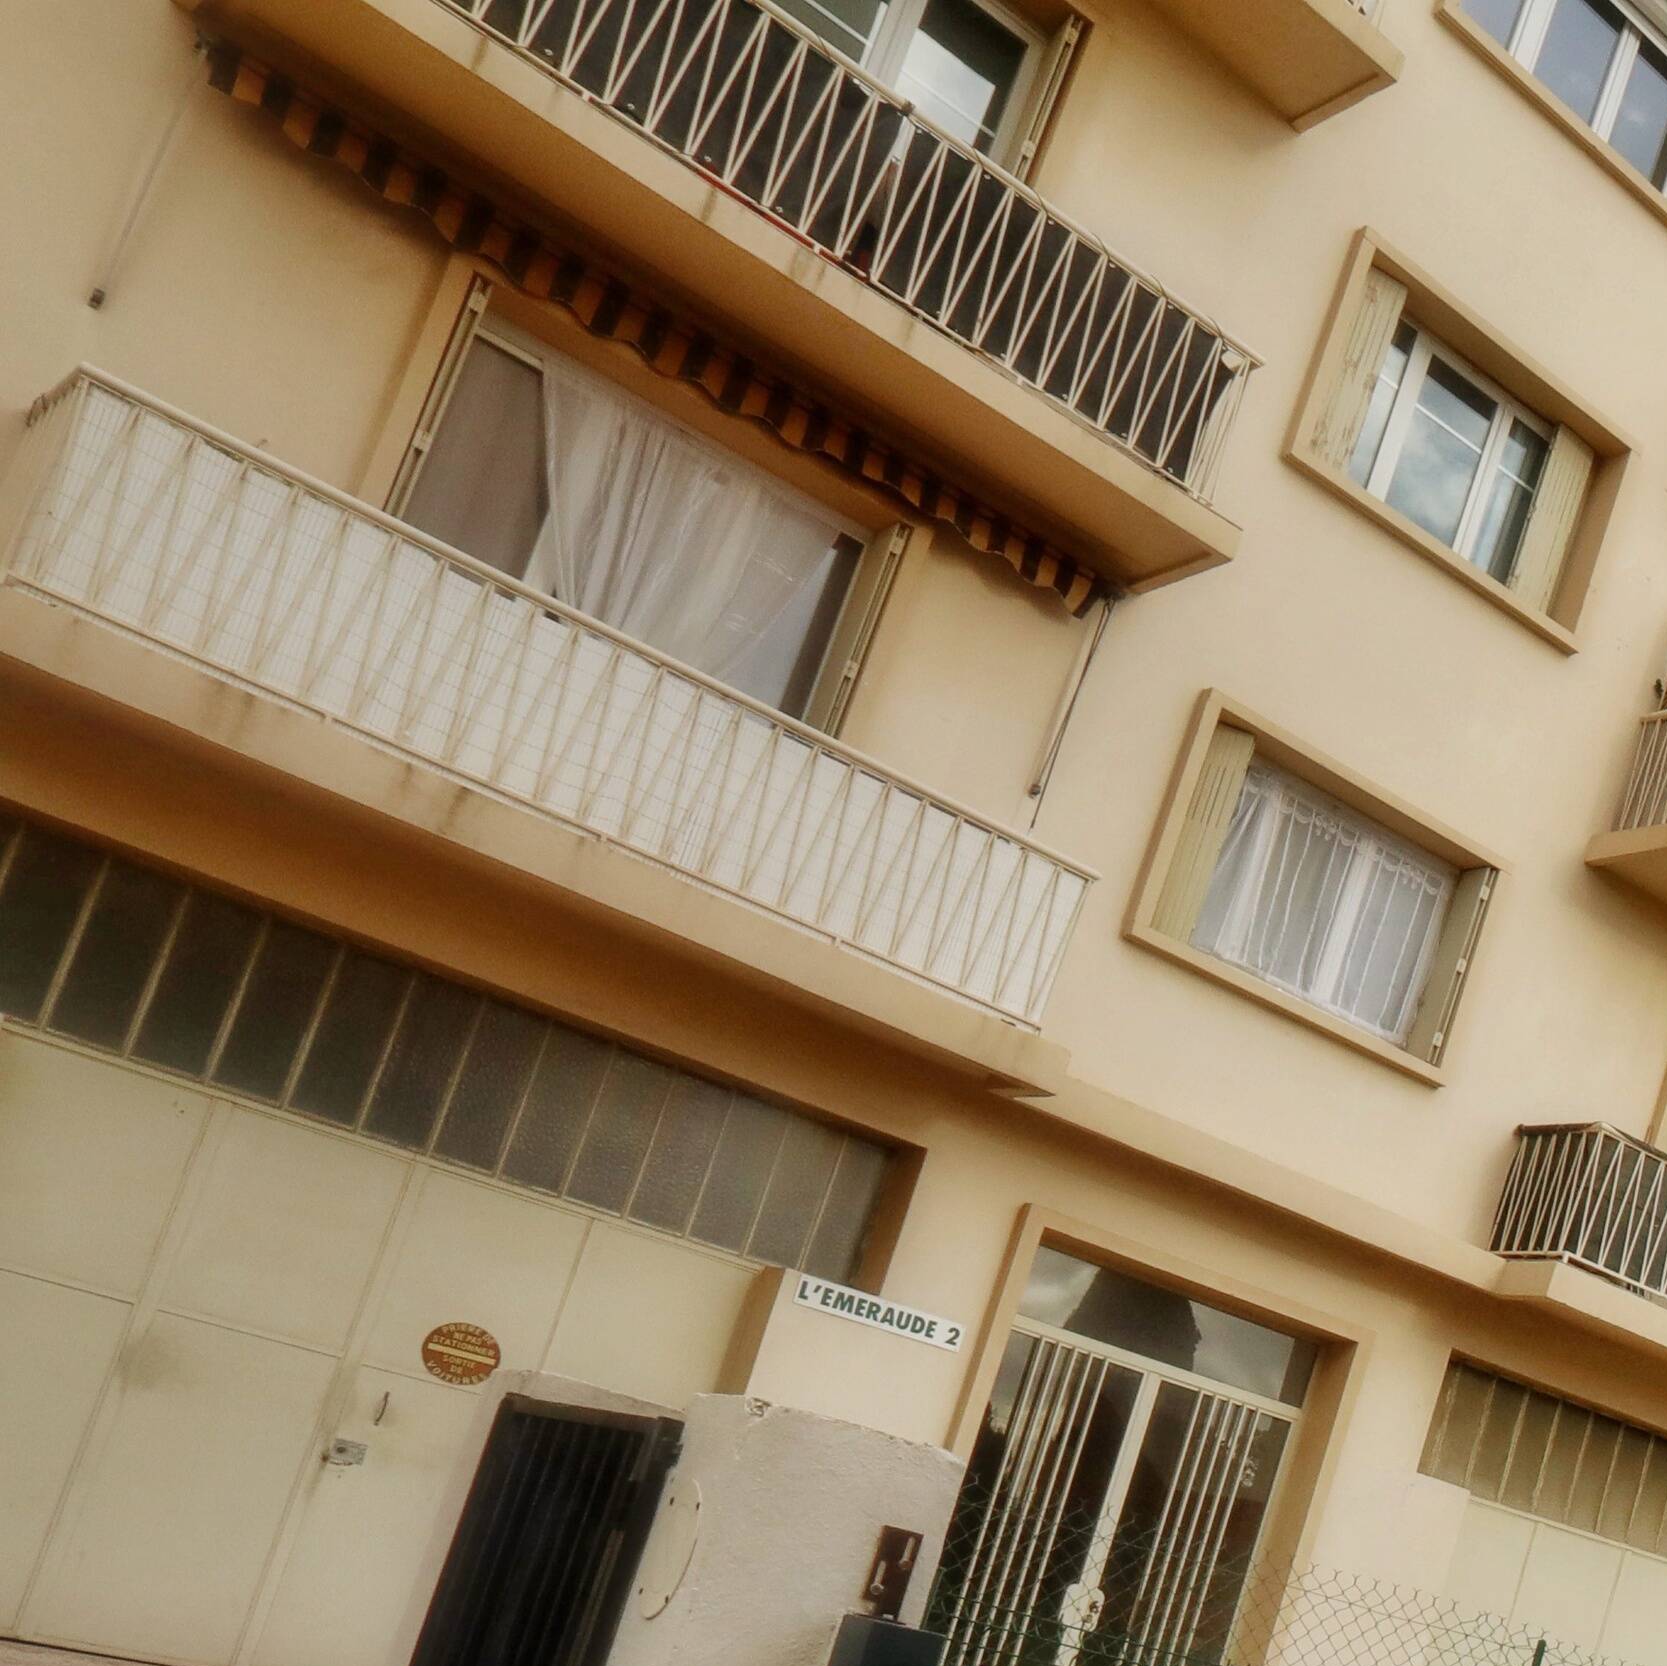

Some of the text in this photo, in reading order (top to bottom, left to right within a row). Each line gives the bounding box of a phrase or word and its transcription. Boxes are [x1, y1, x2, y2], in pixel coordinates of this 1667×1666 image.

[797, 1280, 961, 1346] L'EMERAUDE 2
[432, 1334, 496, 1358] STATIONNER
[442, 1354, 476, 1369] SORTIE
[449, 1364, 464, 1375] DE
